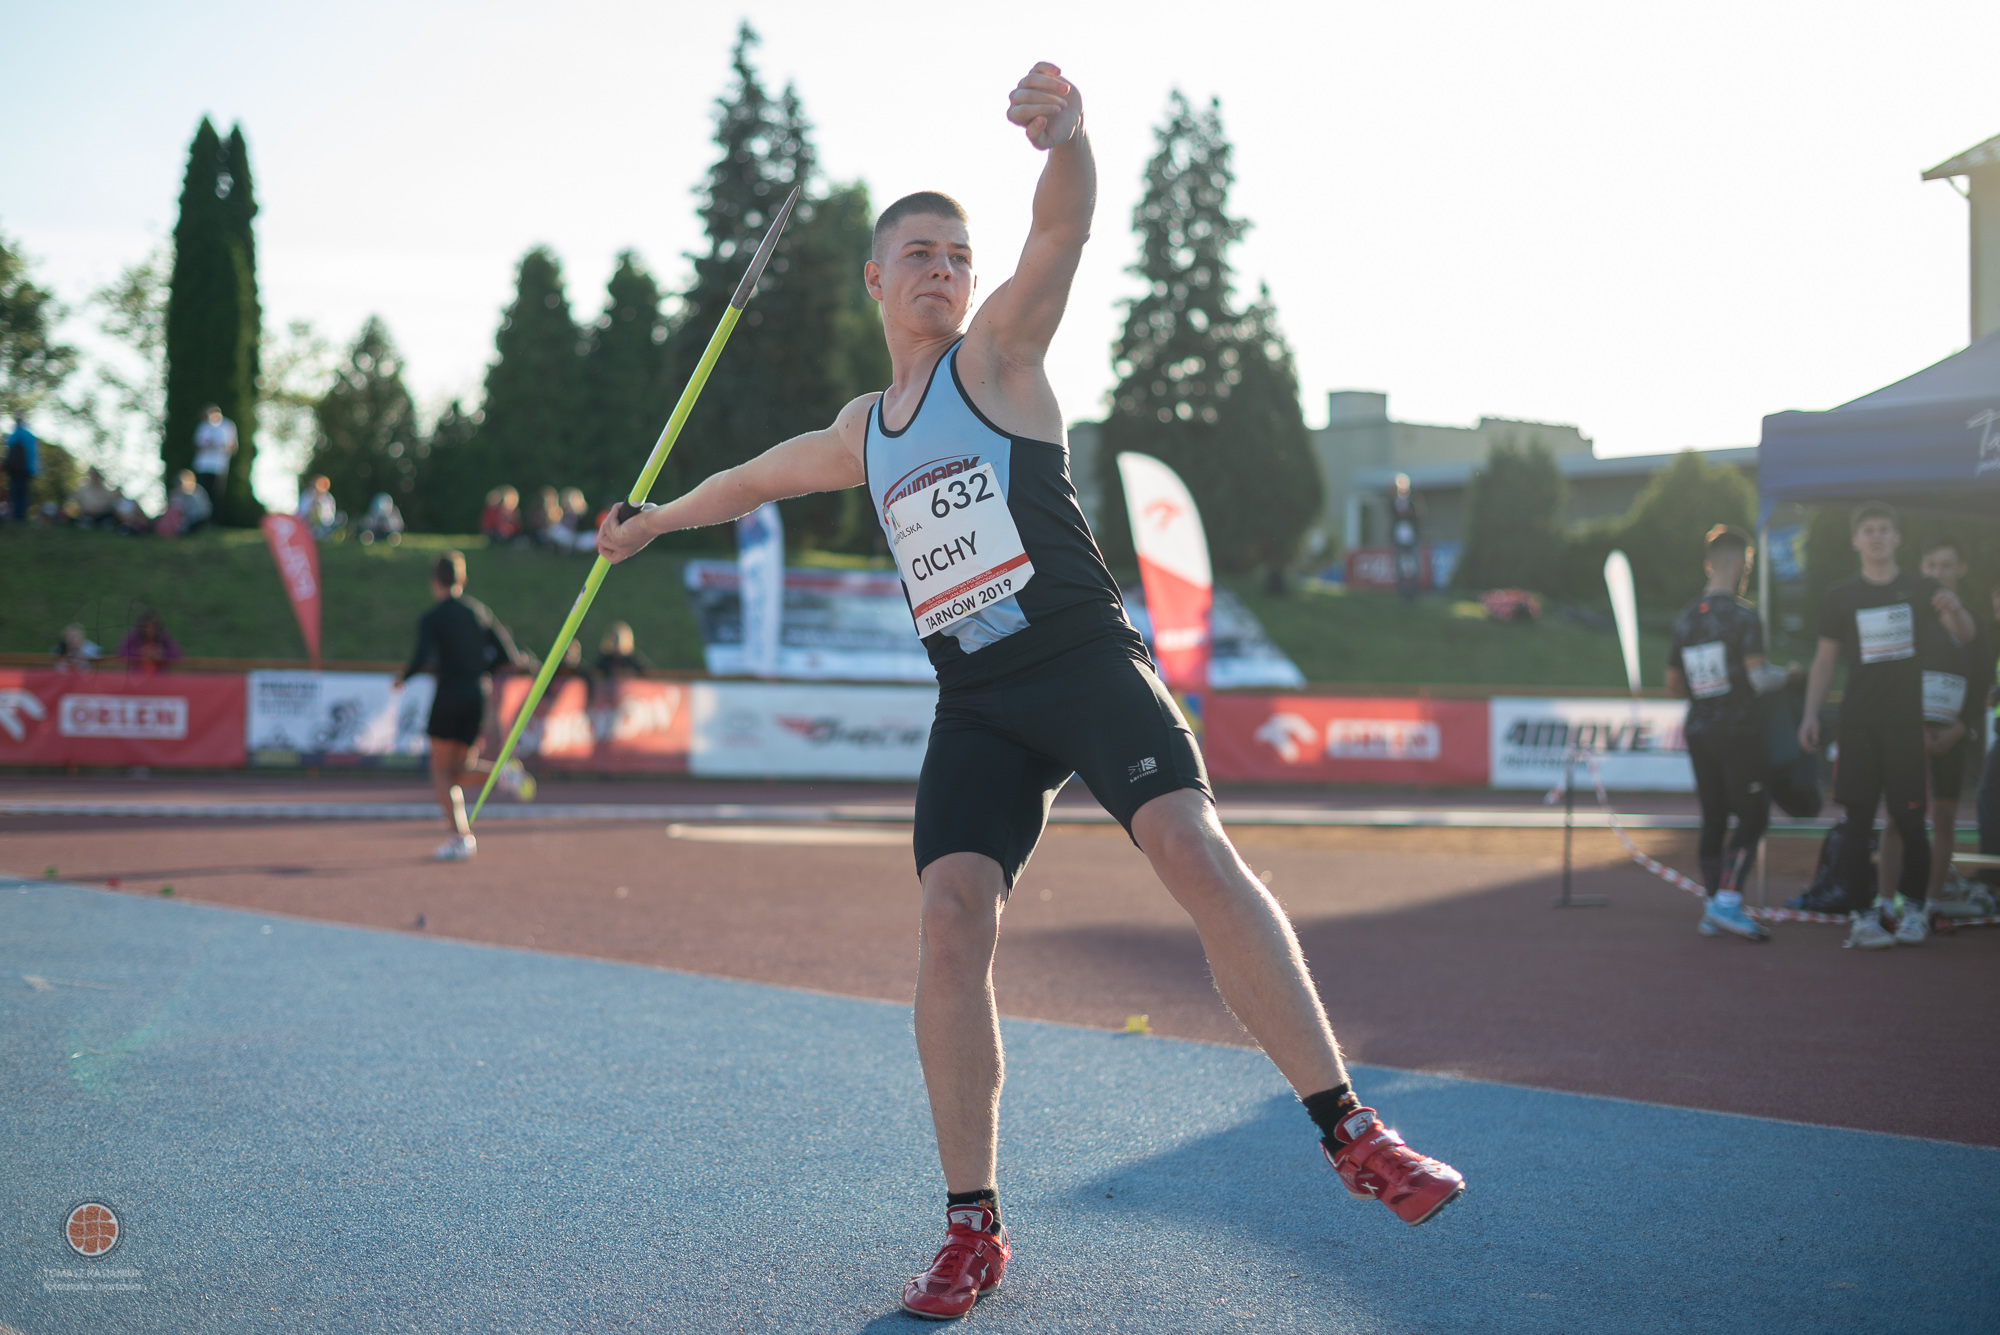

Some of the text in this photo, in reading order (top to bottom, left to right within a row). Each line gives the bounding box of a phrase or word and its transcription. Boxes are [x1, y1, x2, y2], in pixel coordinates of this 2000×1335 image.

[931, 473, 995, 518] 632
[912, 530, 977, 581] CICHY
[926, 578, 1012, 630] TARNÓW 2019
